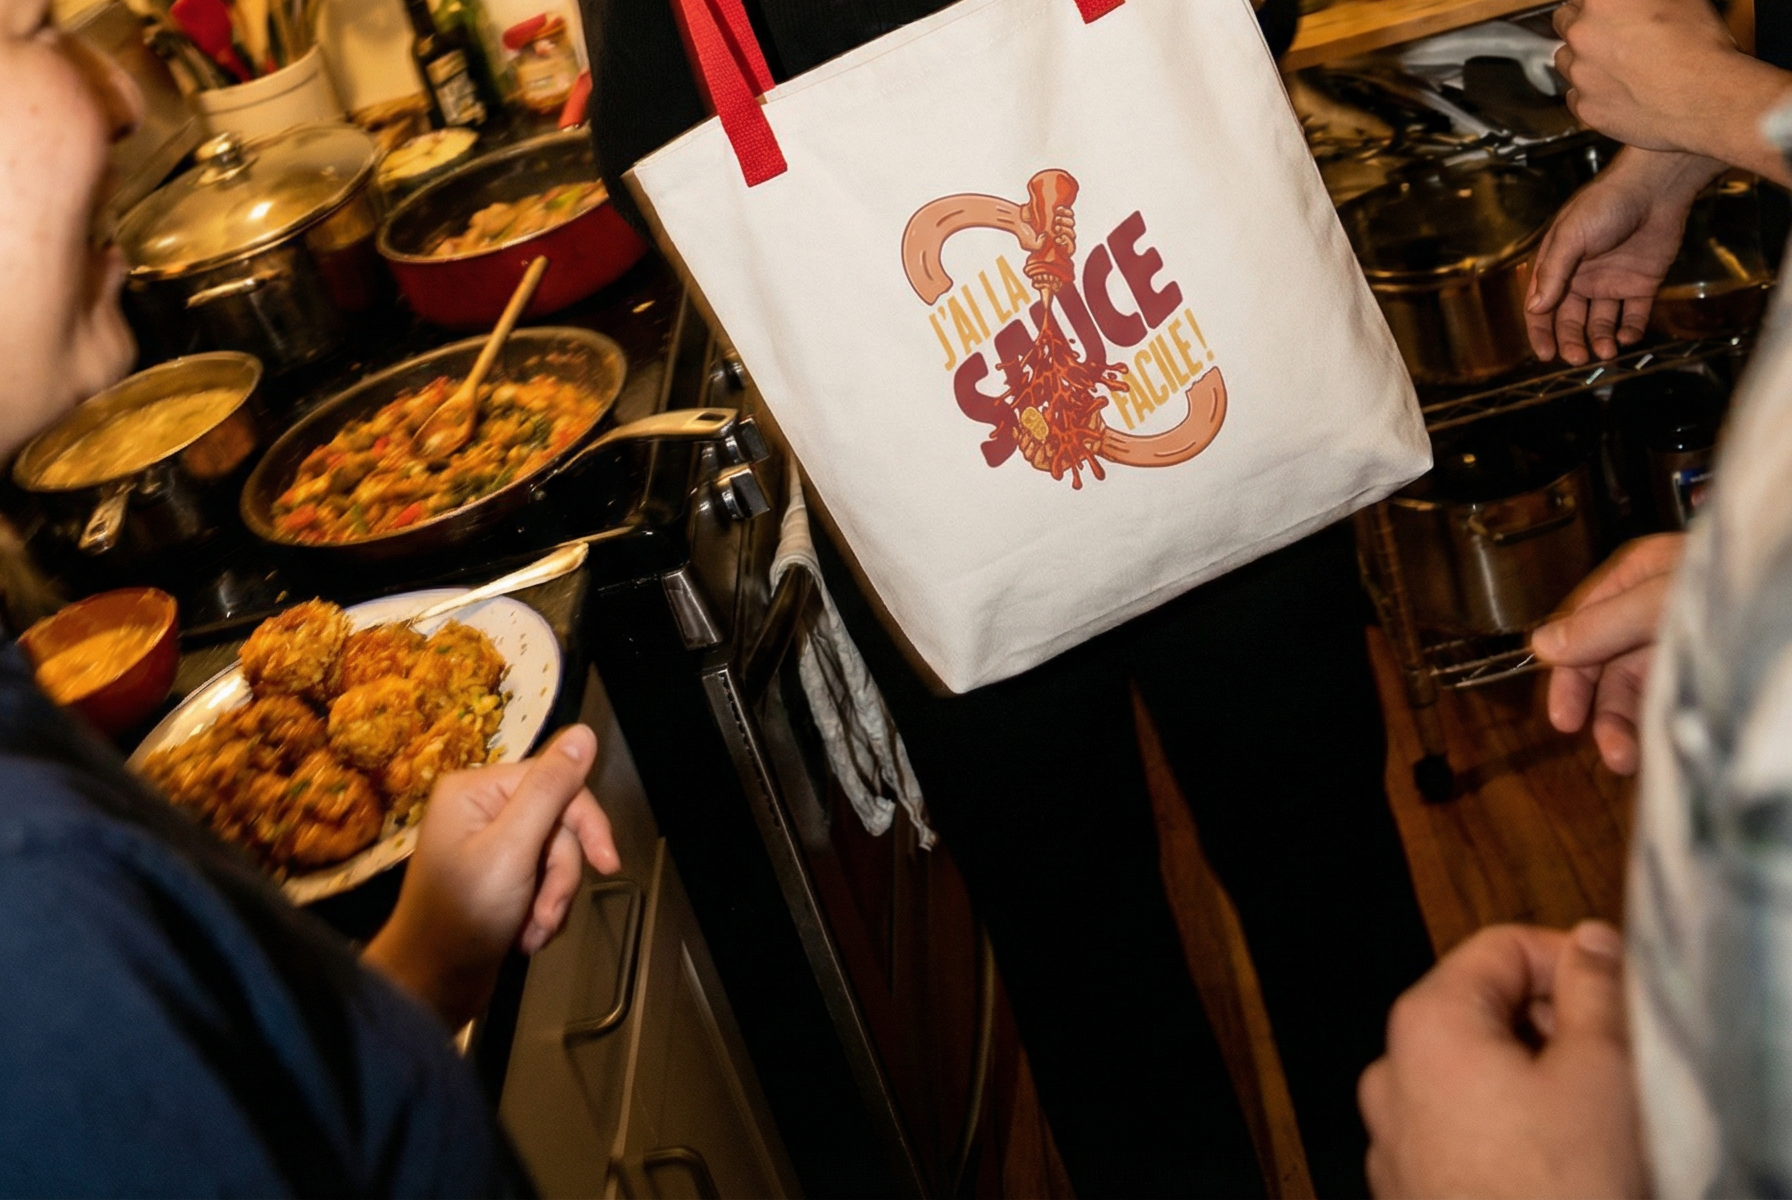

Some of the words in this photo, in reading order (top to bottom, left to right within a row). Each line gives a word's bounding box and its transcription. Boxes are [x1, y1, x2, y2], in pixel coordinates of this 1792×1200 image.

[928, 284, 992, 372] J'AI
[977, 254, 1033, 325] LA
[953, 210, 1184, 469] SAUCE
